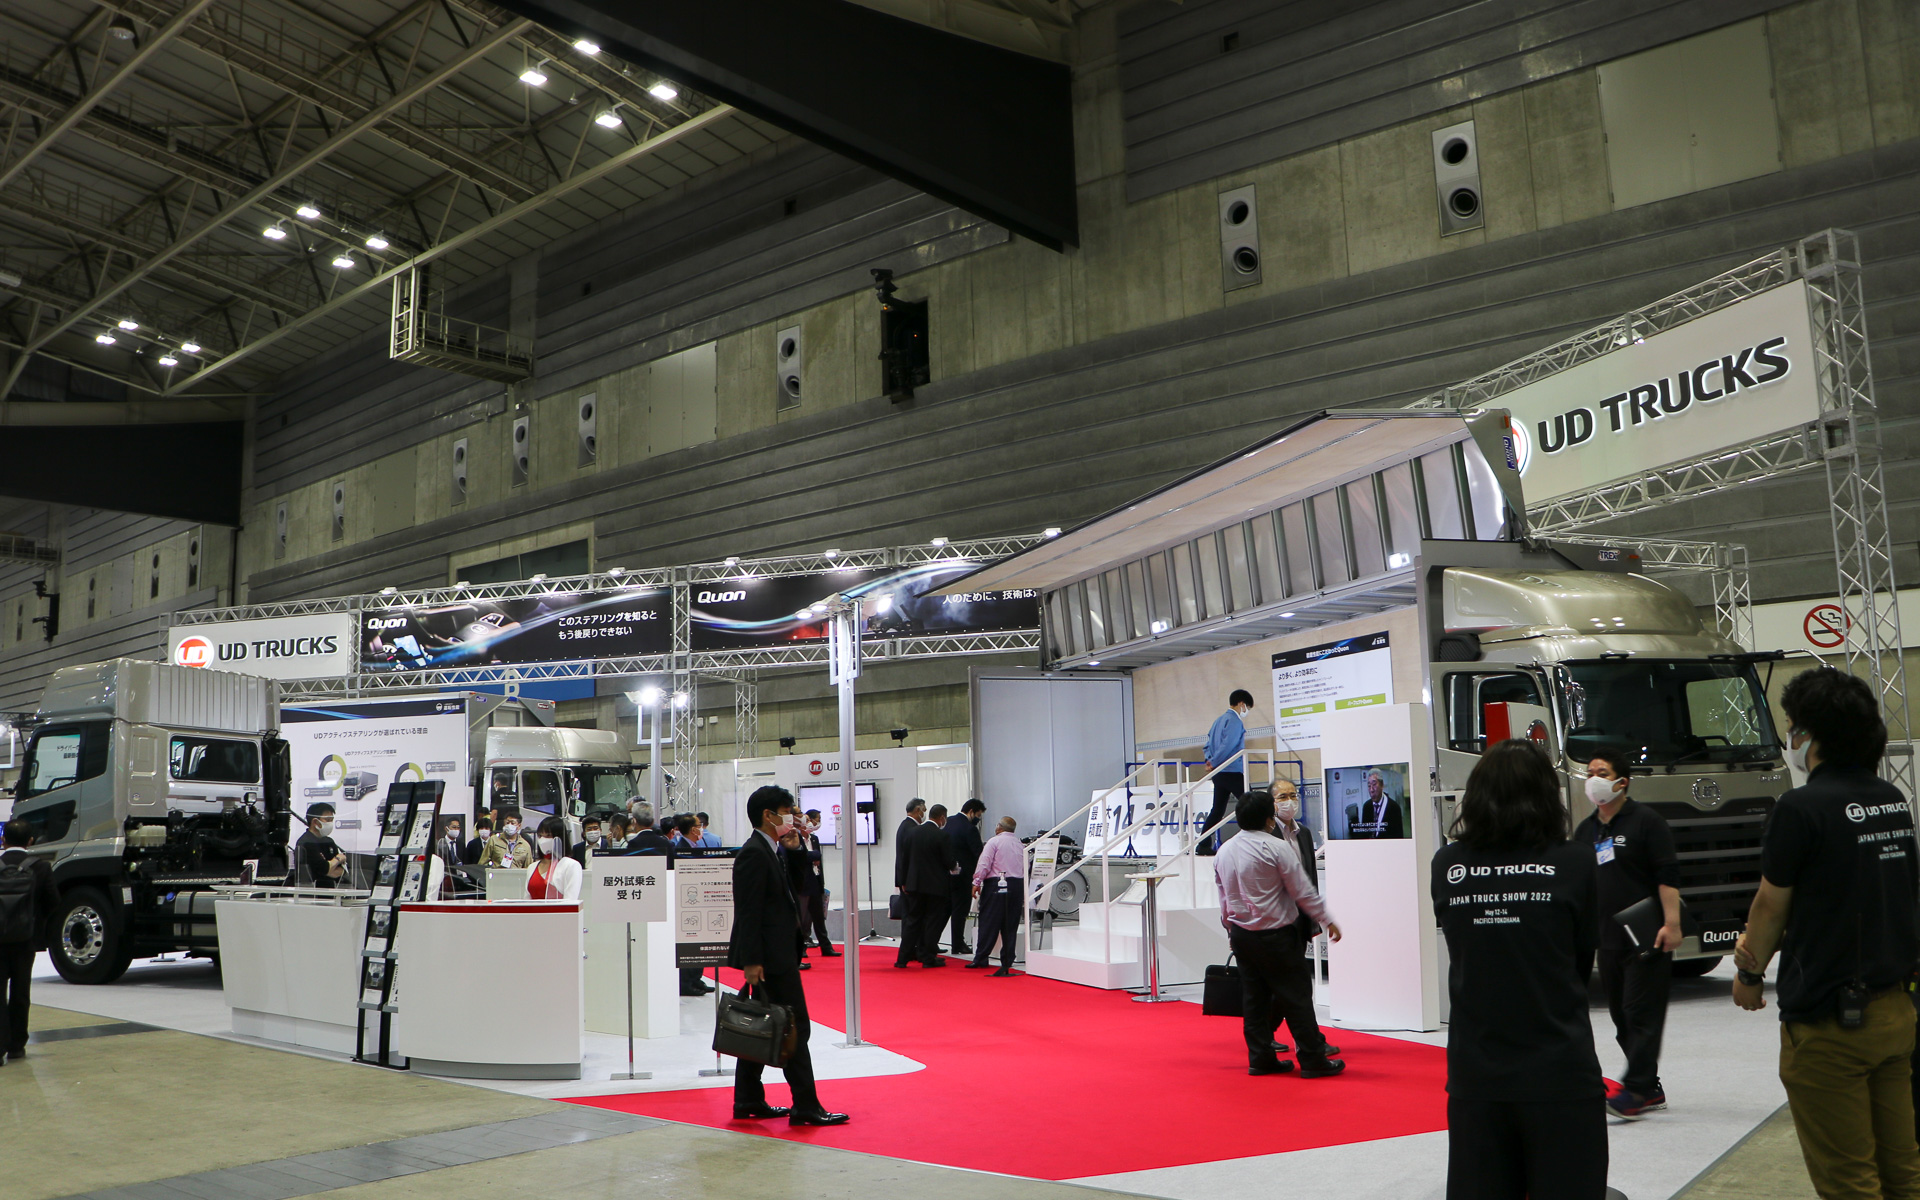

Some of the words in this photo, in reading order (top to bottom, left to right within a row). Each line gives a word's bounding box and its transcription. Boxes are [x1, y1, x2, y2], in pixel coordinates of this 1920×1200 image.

[1537, 408, 1593, 453] UD
[1600, 336, 1790, 432] TRUCKS
[697, 590, 746, 603] Quon
[367, 617, 407, 630] Quon
[558, 610, 658, 627] このステアリングを知ると
[558, 626, 633, 640] もう後戻りできない
[218, 642, 248, 661] UD
[252, 635, 338, 659] TRUCKS
[809, 763, 823, 772] UD
[826, 762, 840, 772] UD
[1866, 807, 1880, 815] UD
[1449, 868, 1464, 880] UD
[1470, 866, 1491, 876] UD
[1494, 863, 1556, 876] TRUCKS
[603, 875, 656, 887] 屋外試乗会
[617, 889, 628, 900] 受
[631, 889, 642, 900] 付
[1449, 895, 1470, 906] JAPAN
[1473, 894, 1500, 903] TRUCK
[1502, 892, 1528, 902] SHOW
[1530, 892, 1552, 902] 2022
[1703, 930, 1740, 943] Quon
